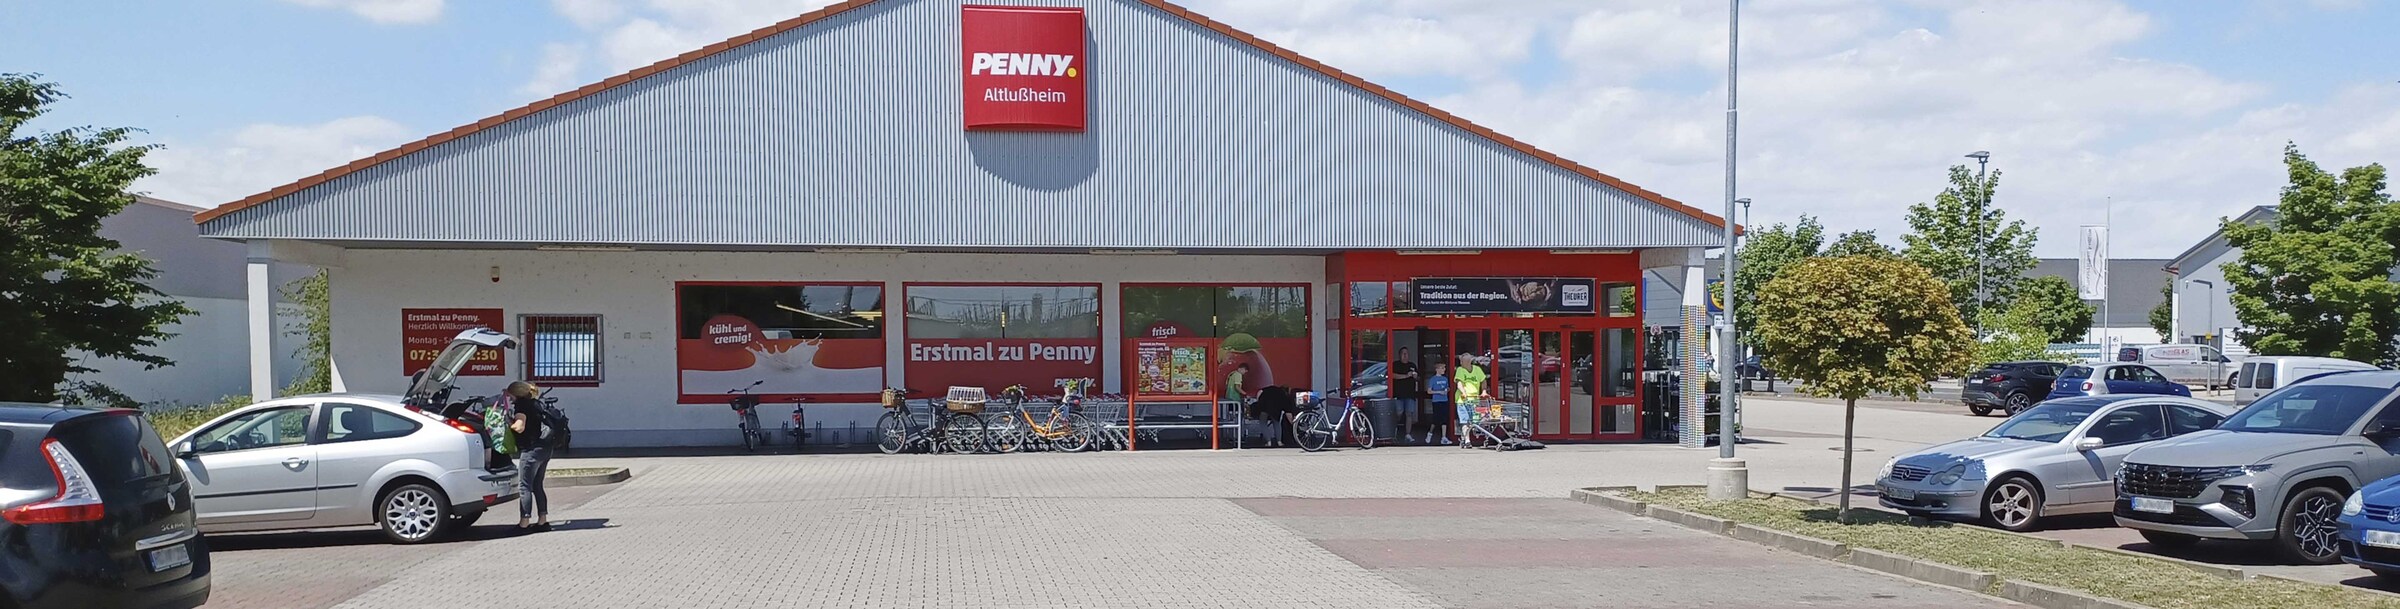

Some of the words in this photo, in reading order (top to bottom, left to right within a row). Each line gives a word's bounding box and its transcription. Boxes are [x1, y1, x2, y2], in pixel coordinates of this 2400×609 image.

[971, 52, 1077, 78] PENNY.
[984, 87, 1066, 103] Altlußheim
[1420, 291, 1452, 299] Tradition
[1480, 292, 1508, 300] Region.
[408, 314, 439, 322] Erstmal
[453, 314, 480, 323] Penny.
[709, 323, 732, 334] kühl
[733, 324, 747, 332] und
[1152, 326, 1177, 337] frisch
[408, 337, 437, 345] Montag
[714, 333, 752, 344] cremig!
[910, 342, 994, 362] Erstmal
[998, 345, 1024, 361] zu
[1029, 342, 1096, 365] Penny
